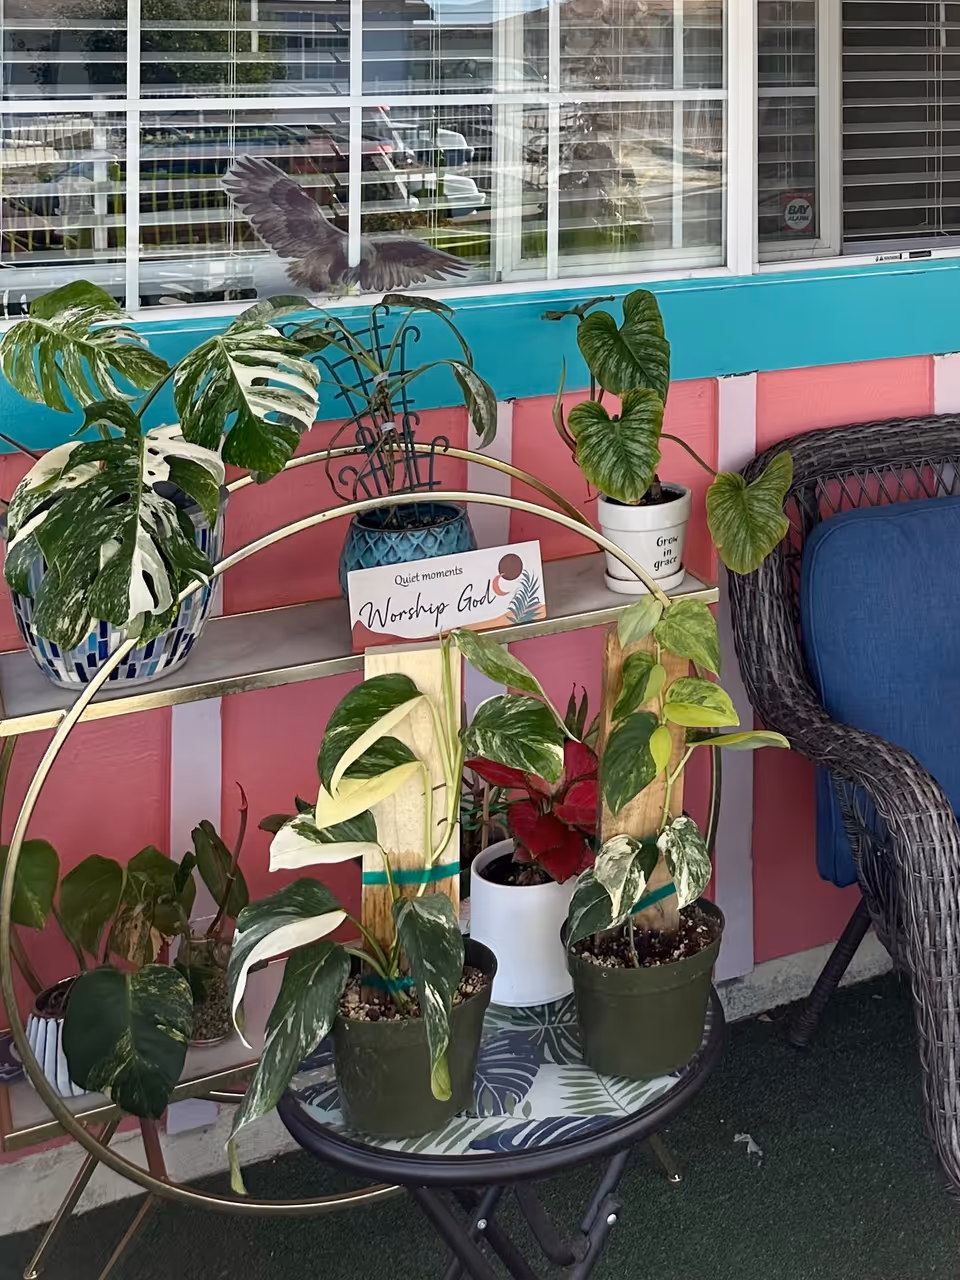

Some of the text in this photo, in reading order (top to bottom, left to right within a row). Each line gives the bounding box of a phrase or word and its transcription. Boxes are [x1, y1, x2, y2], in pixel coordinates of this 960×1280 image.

[788, 204, 810, 215] BAY
[656, 535, 679, 547] Grow
[663, 548, 672, 557] in
[653, 556, 678, 572] grace
[394, 565, 464, 587] Quiet moments
[358, 579, 497, 629] Worship God
